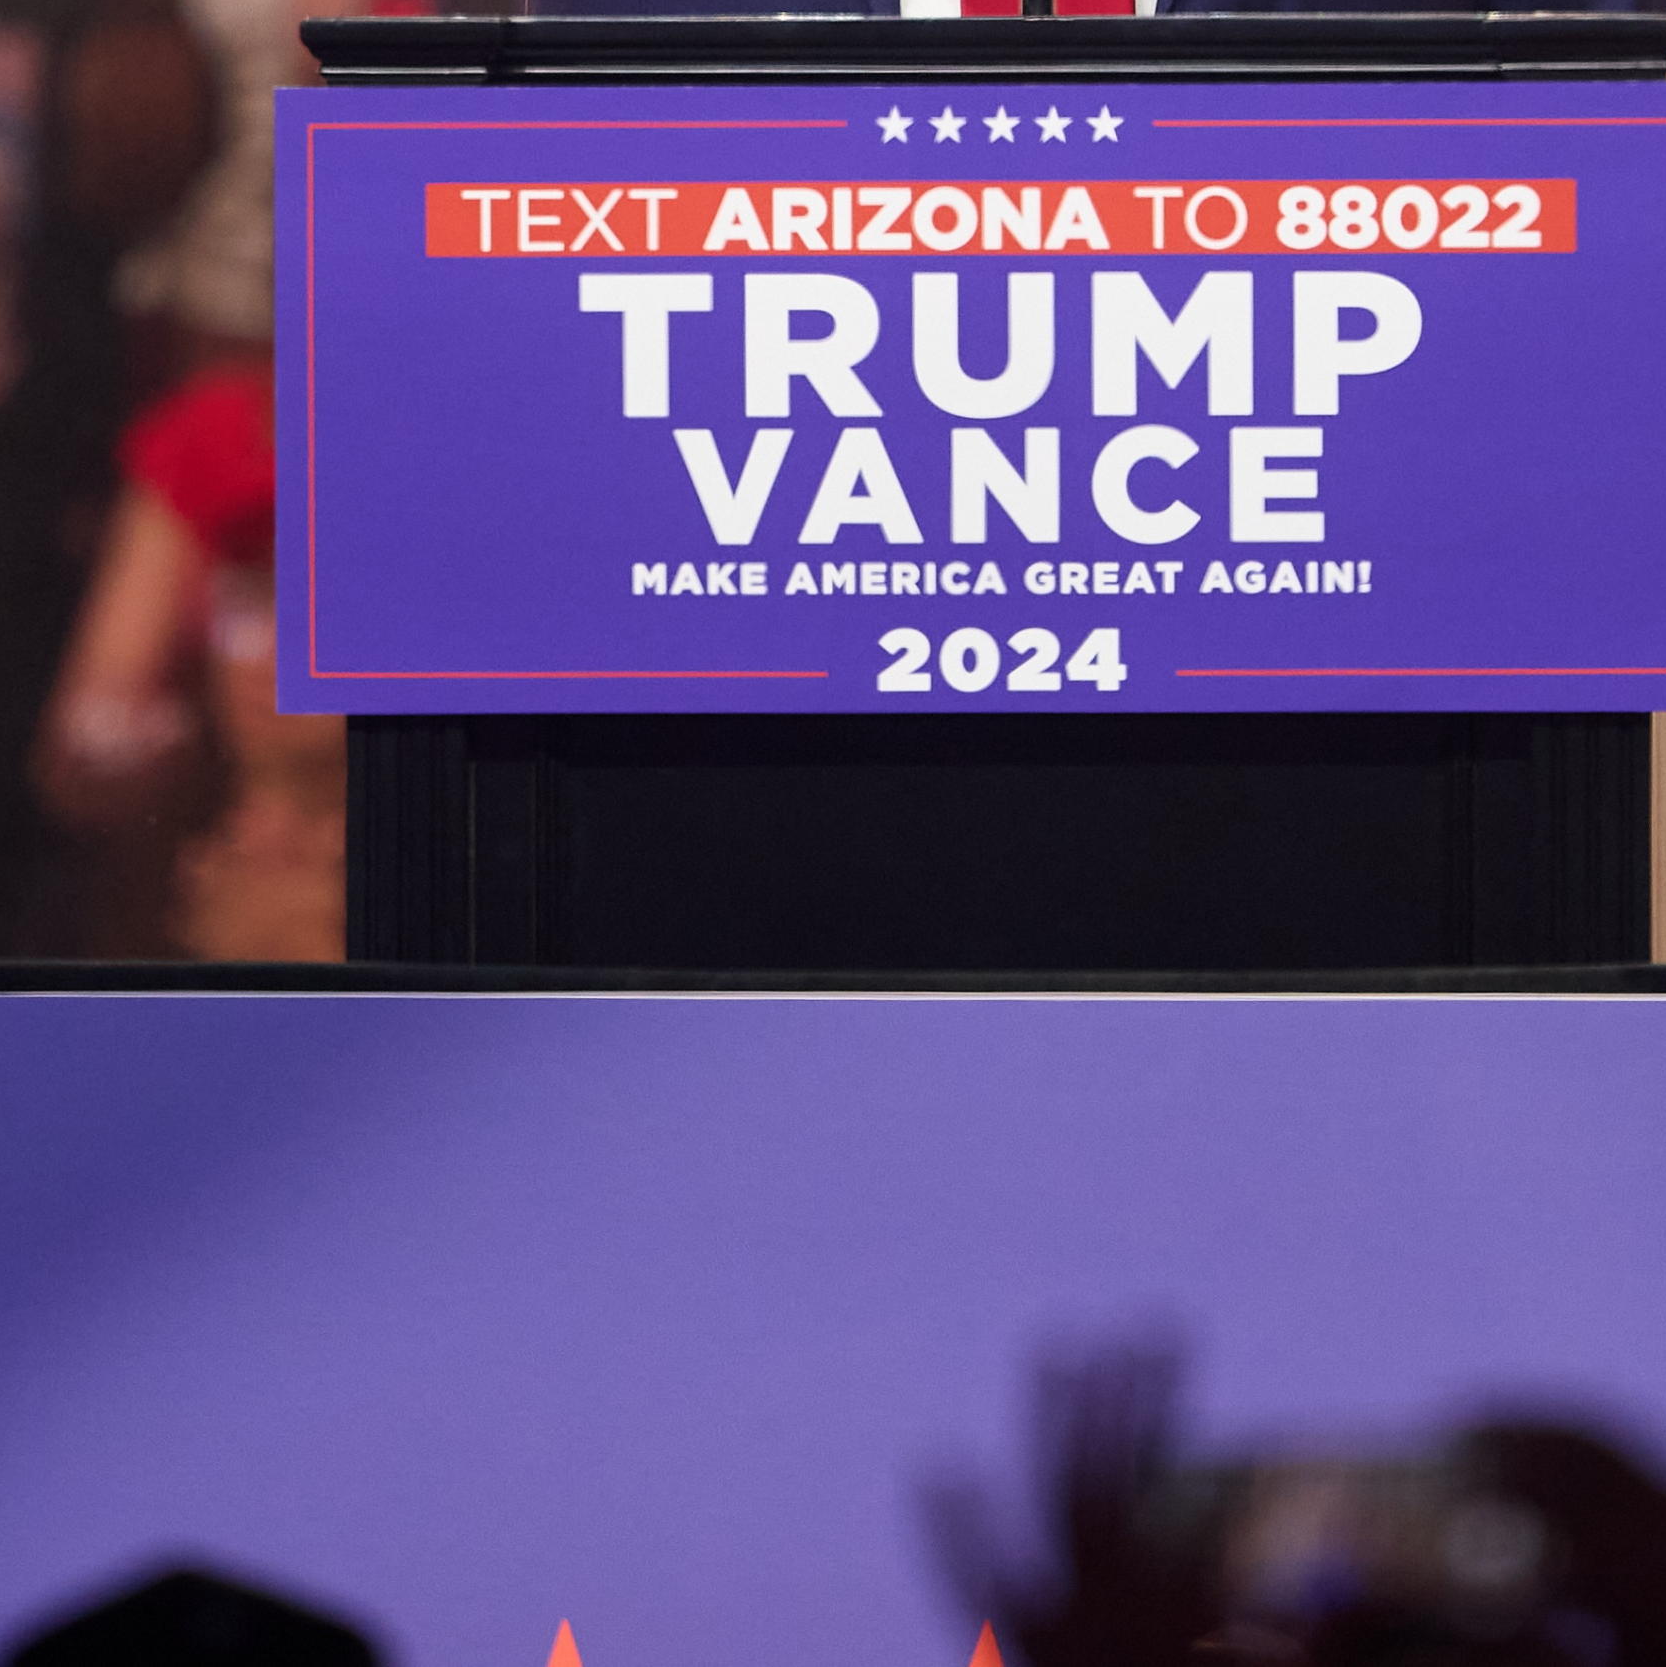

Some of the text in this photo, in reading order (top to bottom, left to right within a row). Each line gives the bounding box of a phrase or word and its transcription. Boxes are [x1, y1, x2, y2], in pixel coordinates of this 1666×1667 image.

[460, 183, 1543, 254] TEXT ARIZONA TO 88022
[578, 269, 1424, 420] TRUMP
[672, 423, 1326, 546] VANCE
[631, 559, 1372, 596] MAKE AMERICA GREAT AGAIN!
[876, 626, 1128, 694] 2024
